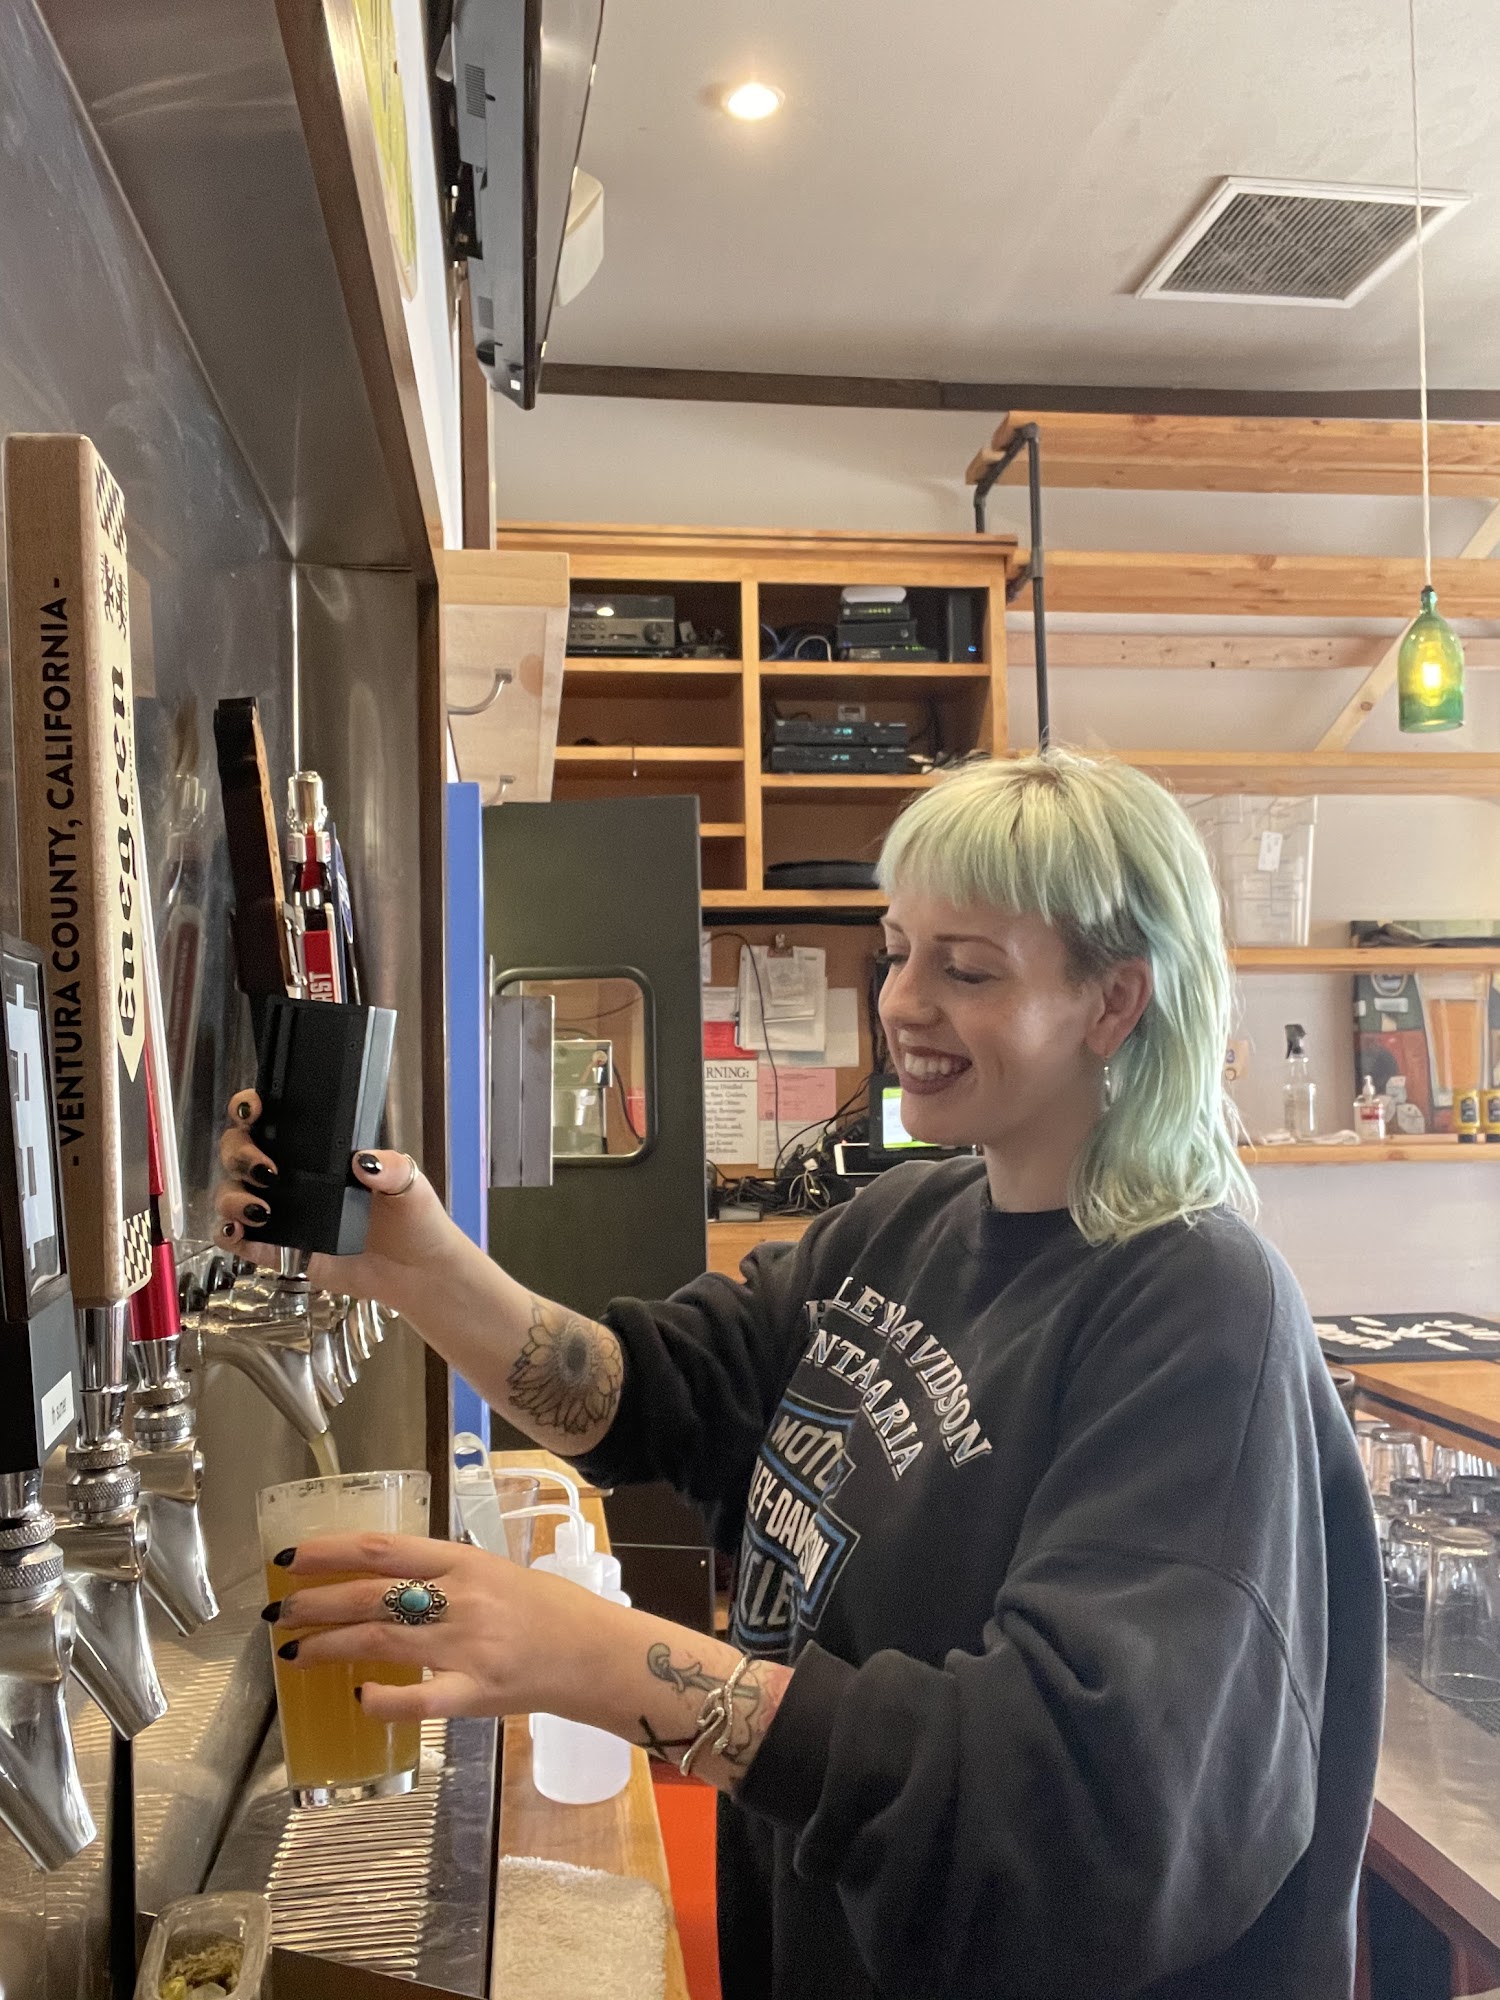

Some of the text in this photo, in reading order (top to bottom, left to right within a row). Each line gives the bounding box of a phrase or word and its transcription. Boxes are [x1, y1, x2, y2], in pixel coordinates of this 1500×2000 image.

[40, 598, 75, 810] CALIFORNIA
[48, 819, 83, 972] COUNTY,
[111, 665, 137, 1038] Enegren
[52, 980, 86, 1147] VENTURA
[706, 1066, 749, 1078] RNING:
